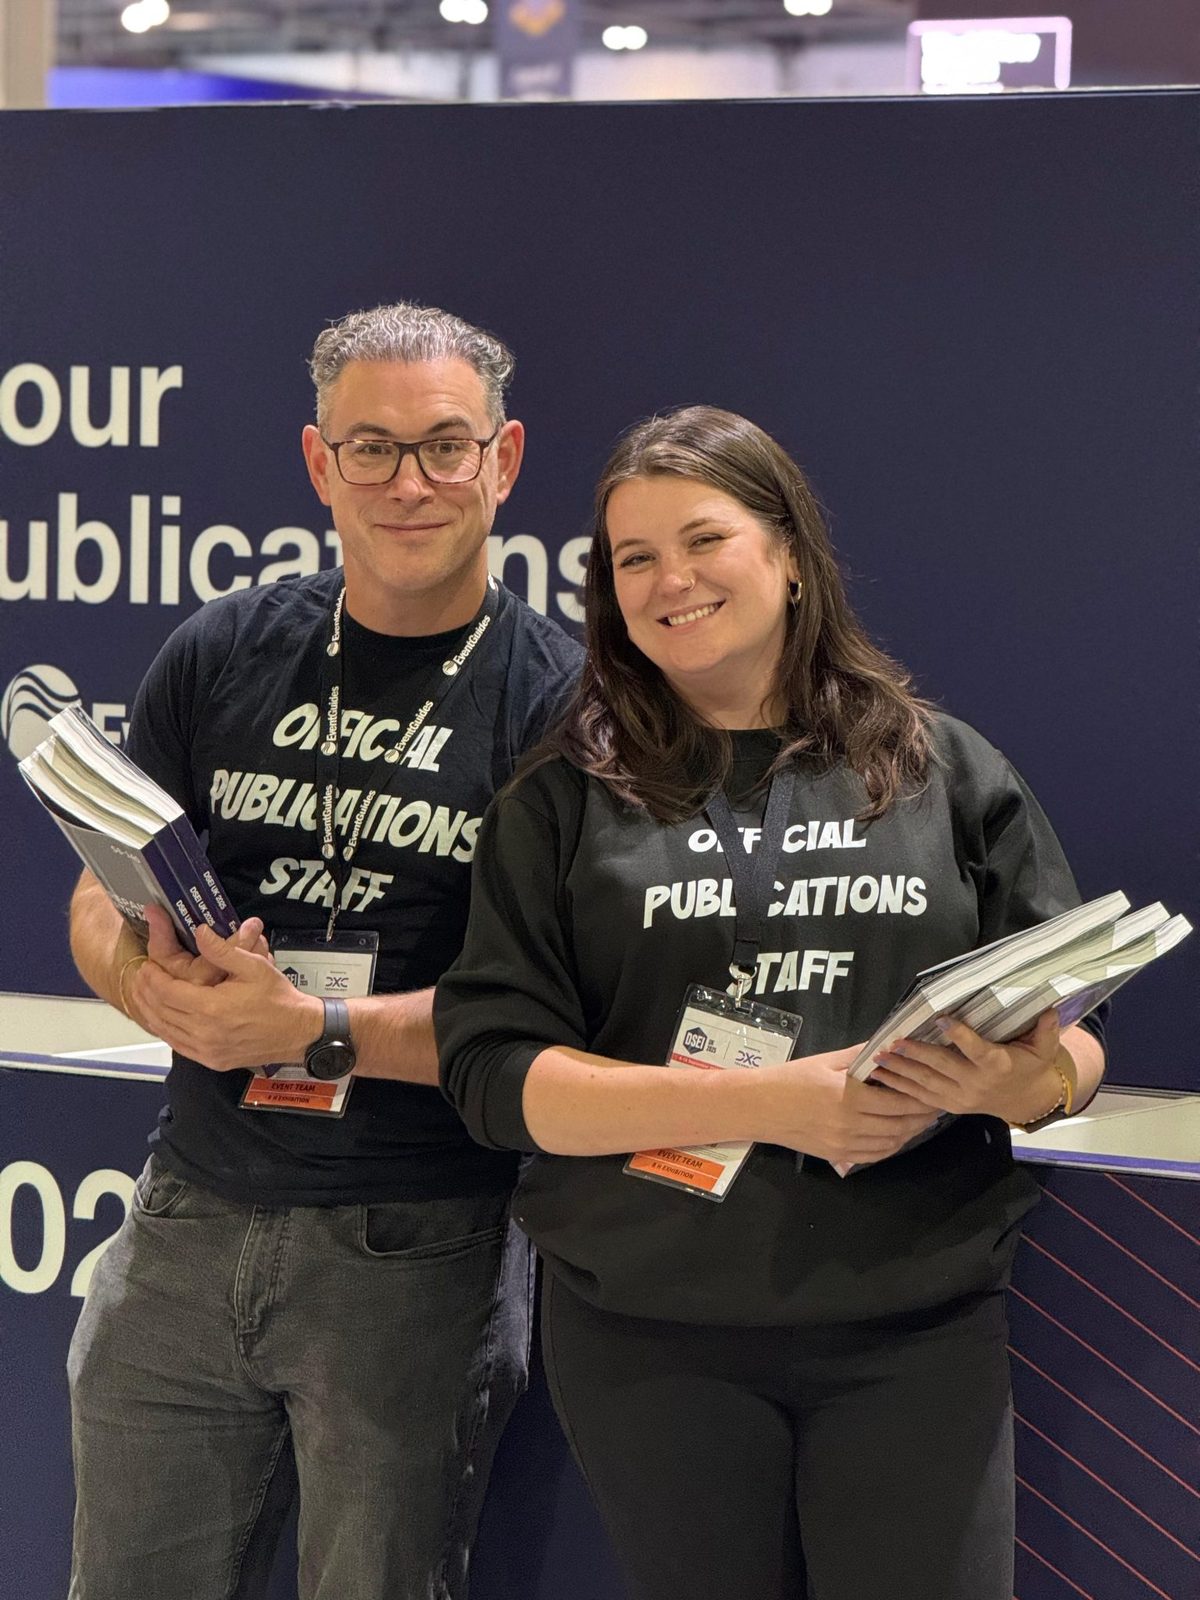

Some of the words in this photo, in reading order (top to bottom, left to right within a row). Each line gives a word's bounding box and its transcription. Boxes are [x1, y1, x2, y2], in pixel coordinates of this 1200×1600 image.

[453, 614, 491, 666] EventGuides
[272, 703, 454, 773] OFICAL
[326, 686, 340, 742] EventGuides
[395, 699, 434, 753] EventGuides
[322, 784, 334, 843] EventGuides
[348, 789, 376, 847] EventGuides
[688, 818, 867, 854] OFCIAL
[198, 901, 208, 913] UK
[259, 857, 394, 913] STAFF
[643, 875, 928, 929] PUBLATIONS
[684, 1032, 706, 1050] DSEI
[271, 1083, 294, 1091] EVENT
[295, 1083, 316, 1092] TEAM
[657, 1149, 682, 1162] EVENT
[682, 1156, 703, 1169] TEAM
[662, 1165, 695, 1179] EXHIBITION
